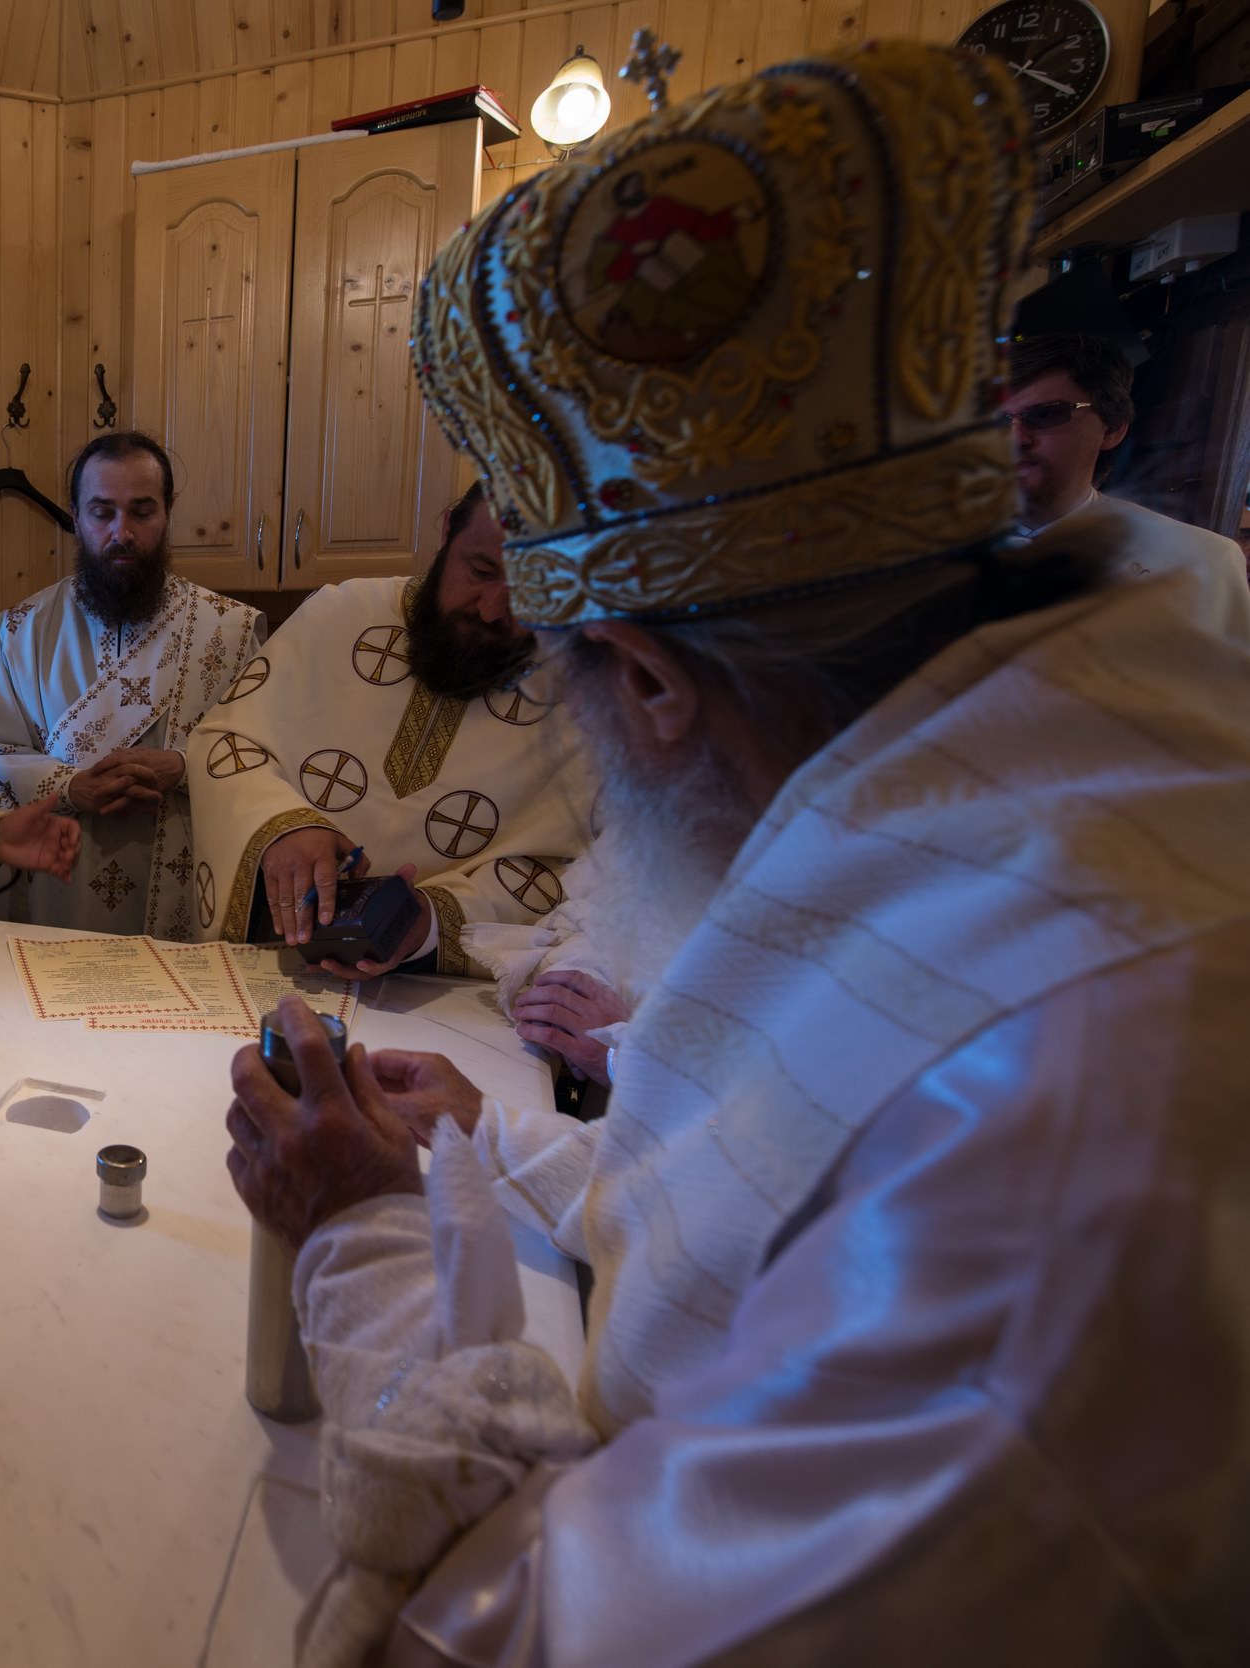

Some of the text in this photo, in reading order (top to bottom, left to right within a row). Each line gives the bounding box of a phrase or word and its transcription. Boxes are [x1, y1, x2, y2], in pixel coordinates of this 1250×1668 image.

[1017, 12, 1040, 29] 12
[1053, 17, 1061, 33] 1
[993, 23, 1006, 39] 11
[1063, 34, 1082, 50] 2
[1069, 58, 1085, 74] 3
[1033, 102, 1050, 118] 5
